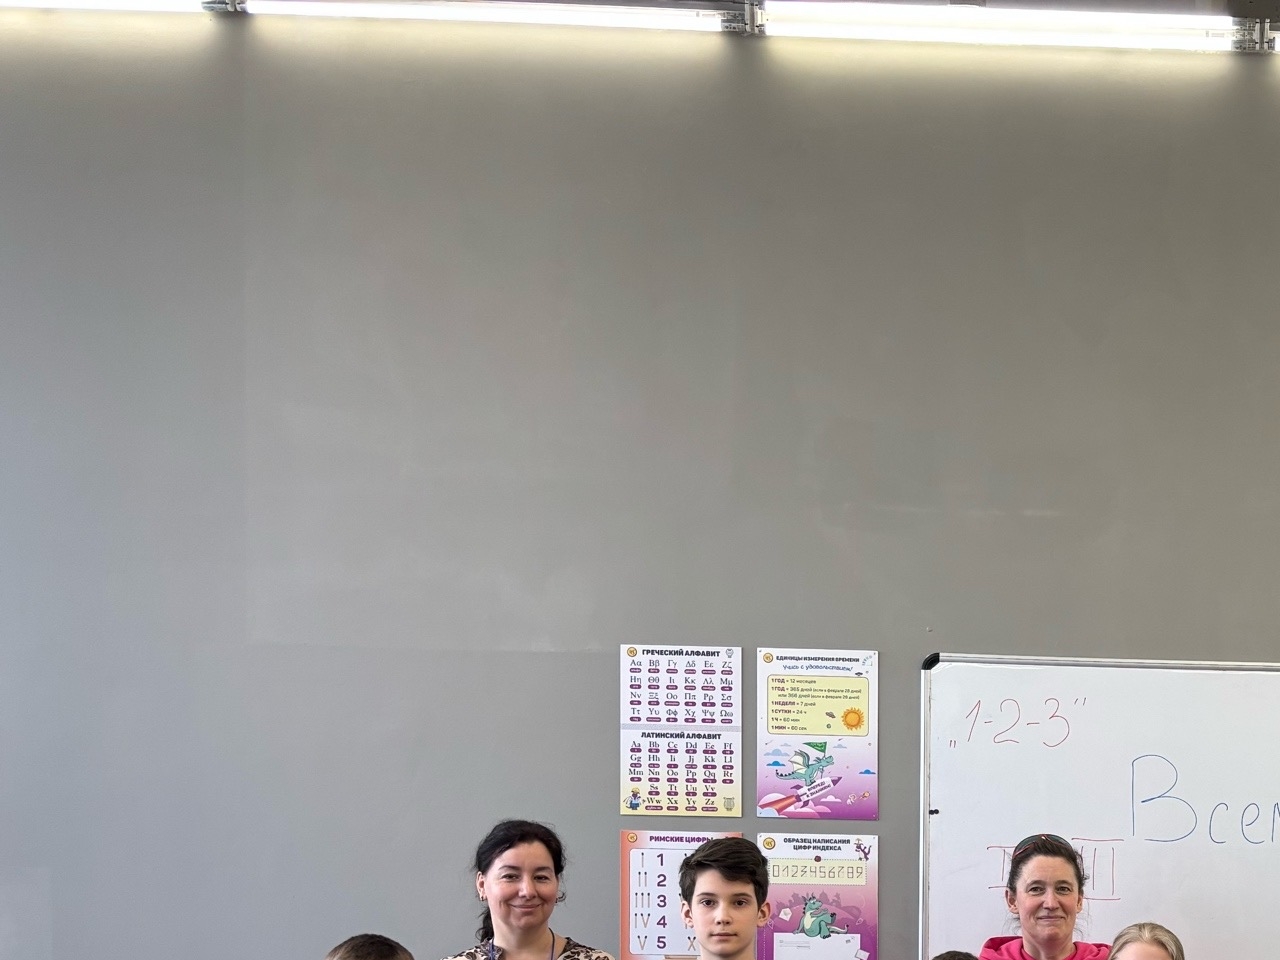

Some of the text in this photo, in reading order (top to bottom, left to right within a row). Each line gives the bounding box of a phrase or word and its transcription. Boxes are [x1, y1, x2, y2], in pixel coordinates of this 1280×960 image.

[657, 854, 664, 866] 1
[657, 874, 666, 887] 2
[657, 895, 666, 908] 3
[657, 916, 667, 928] 4
[657, 936, 666, 949] 5
